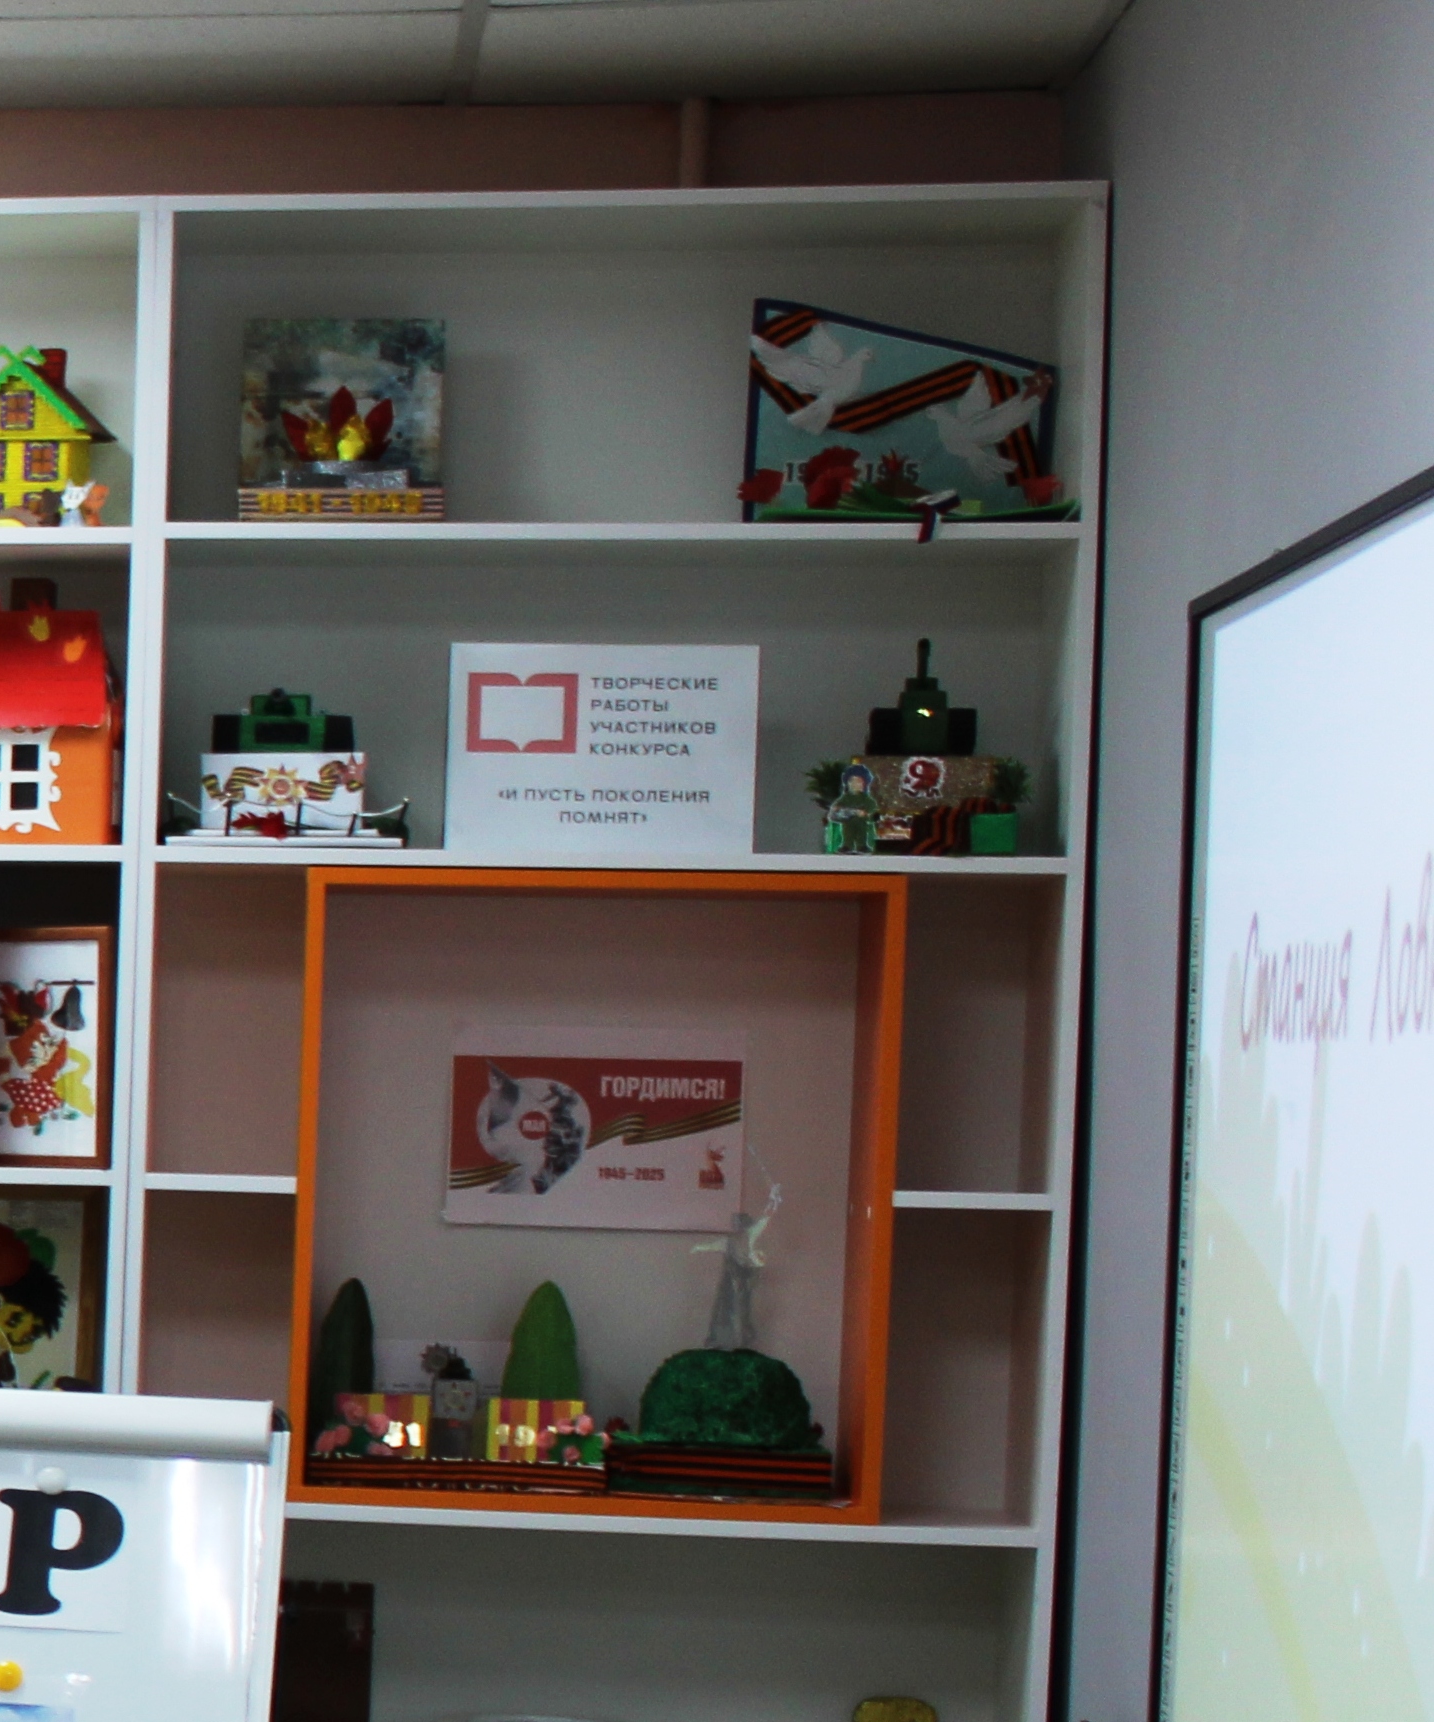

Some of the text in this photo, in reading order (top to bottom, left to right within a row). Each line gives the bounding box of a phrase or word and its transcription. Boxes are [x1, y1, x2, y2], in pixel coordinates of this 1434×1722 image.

[591, 677, 718, 690] ТВОРЧЕСКИЕ
[590, 699, 669, 712] РАБОТЫ
[590, 721, 716, 734] УЧАСТНИКОВ
[589, 743, 690, 756] КОНКУРСА
[498, 788, 710, 803] «И ПУСТЬ ПОКОЛЕНИЯ
[559, 811, 647, 824] ПОМНЯТ»
[1241, 851, 1434, 1076] Станция Лов
[600, 1076, 726, 1102] ГОРДИМСЯ!
